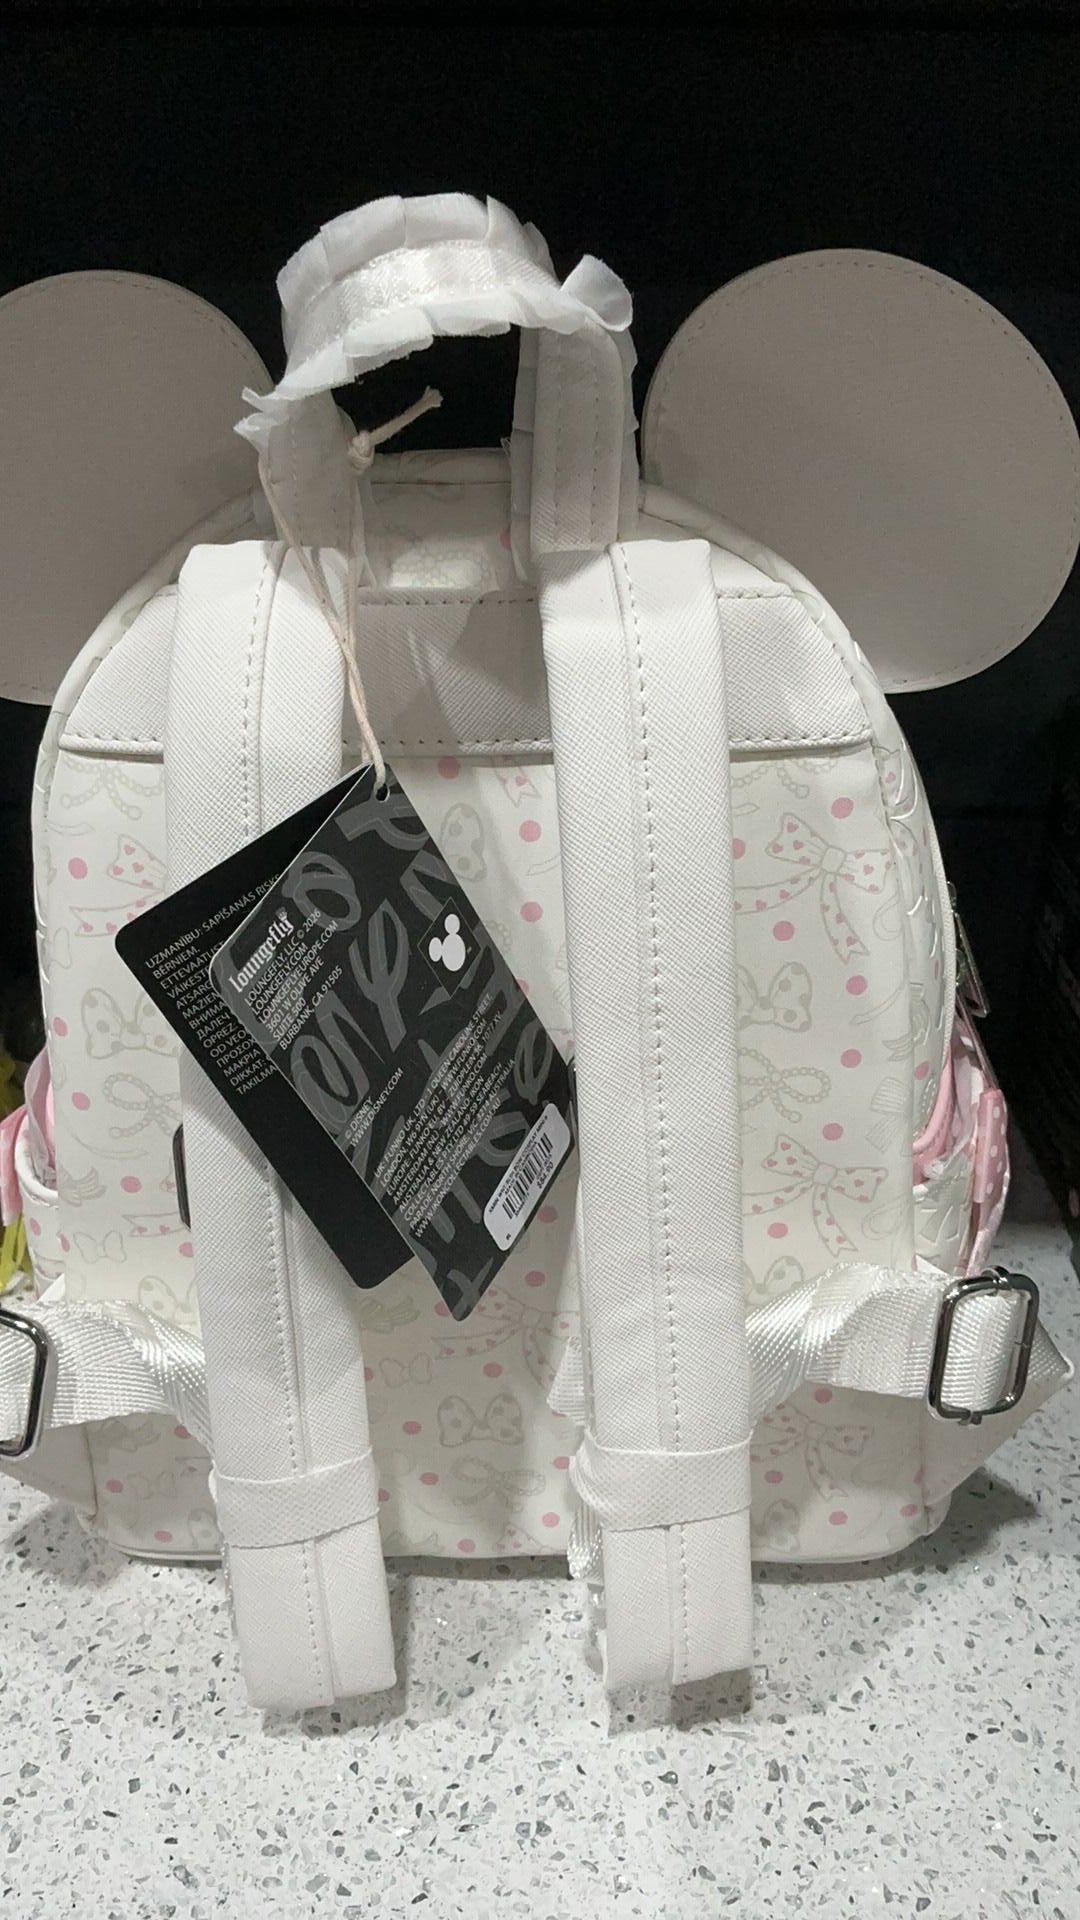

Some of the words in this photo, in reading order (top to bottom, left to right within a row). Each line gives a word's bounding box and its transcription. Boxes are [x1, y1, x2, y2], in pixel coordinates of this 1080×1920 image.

[228, 910, 295, 994] loungefly
[259, 918, 338, 1024] LOUNGEFLYEUROPE.COM
[283, 934, 299, 956] LLC
[302, 907, 321, 933] 2026
[251, 941, 308, 1016] LOUNGEFLY.COM
[266, 1007, 284, 1033] 3601
[281, 997, 292, 1012] W
[289, 971, 311, 1002] OLIVE
[308, 955, 324, 977] AVE
[273, 1012, 294, 1042] SUITE
[291, 995, 306, 1016] 500
[279, 1002, 314, 1050] BURBANK,
[321, 962, 343, 994] 91505
[209, 1041, 227, 1058] OD
[349, 1095, 373, 1132] DISNEY
[350, 1066, 403, 1148] WWW.DISNEY.COM
[384, 1128, 406, 1163] FUNKO
[413, 1097, 425, 1117] LTD
[430, 1057, 450, 1090] QUEEN
[448, 1018, 475, 1061] CAROLINE
[391, 1146, 428, 1205] AMSTERDAM
[398, 1162, 429, 1213] AUSTRALIA
[432, 1134, 446, 1158] NEW
[469, 1074, 483, 1098] IKON
[403, 1155, 444, 1222] COLLECTABLES
[475, 1060, 502, 1104] SEABEACH
[409, 1191, 433, 1229] PARADE
[430, 1161, 451, 1195] NORTH
[487, 1055, 516, 1102] AUSTRALIA
[409, 1126, 430, 1159] FUNKO
